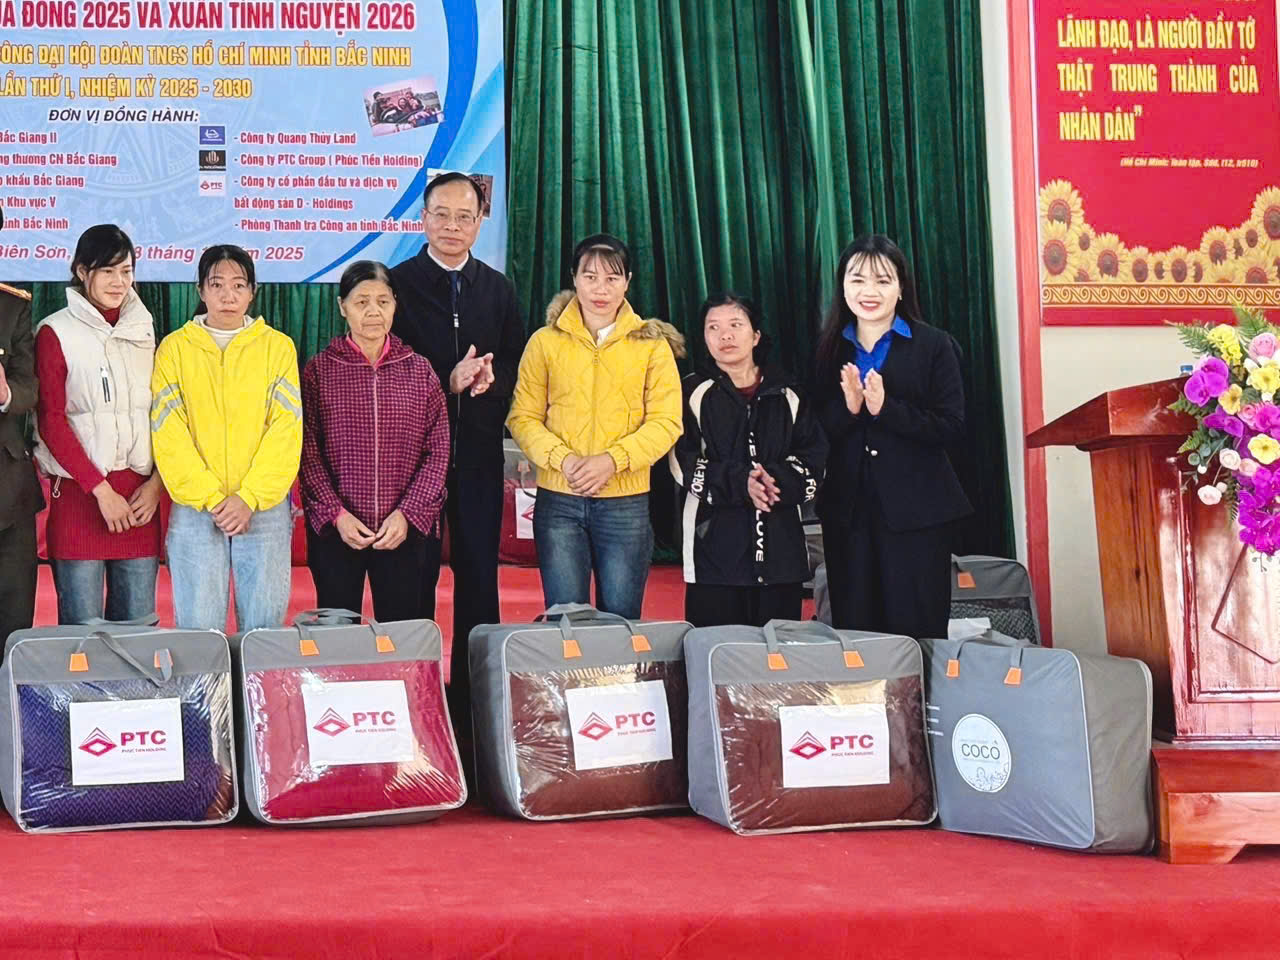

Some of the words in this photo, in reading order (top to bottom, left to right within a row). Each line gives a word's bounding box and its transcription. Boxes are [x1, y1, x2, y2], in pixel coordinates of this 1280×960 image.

[83, 1, 131, 28] 2025
[367, 3, 415, 30] 2026
[37, 45, 64, 69] ĐẠI
[68, 41, 95, 69] HỘI
[99, 41, 143, 65] ĐOÀN
[147, 46, 188, 65] TNCS
[218, 42, 245, 66] CHÍ
[249, 46, 291, 66] MINH
[295, 40, 331, 66] TỈNH
[335, 40, 368, 66] BẮC
[371, 47, 411, 66] NINH
[1057, 58, 1094, 98] THẬT
[1109, 64, 1158, 92] TRUNG
[1169, 59, 1217, 93] THÀNH
[1229, 56, 1259, 93] CỦA
[31, 72, 63, 97] THỨ
[79, 73, 131, 102] NHIỆM
[135, 74, 157, 97] KỲ
[160, 79, 199, 97] 2025
[213, 79, 251, 98] 2030
[49, 108, 81, 121] ĐƠN
[87, 110, 100, 124] VỊ
[152, 108, 199, 122] HÀNH:
[1059, 106, 1101, 140] NHÂN
[19, 132, 47, 144] Giang
[241, 220, 270, 232] Phòng
[274, 220, 301, 231] Thanh
[304, 221, 317, 231] tra
[319, 220, 343, 232] Công
[346, 222, 356, 231] an
[381, 218, 399, 232] Bắc
[402, 221, 423, 232] Ninh
[38, 246, 70, 260] Sơn,
[147, 246, 195, 262] tháng
[265, 247, 304, 260] 2025
[755, 509, 764, 562] LOVE
[354, 711, 395, 726] PTC
[615, 711, 655, 729] PTC
[121, 730, 166, 746] PTC
[831, 735, 874, 750] PTC
